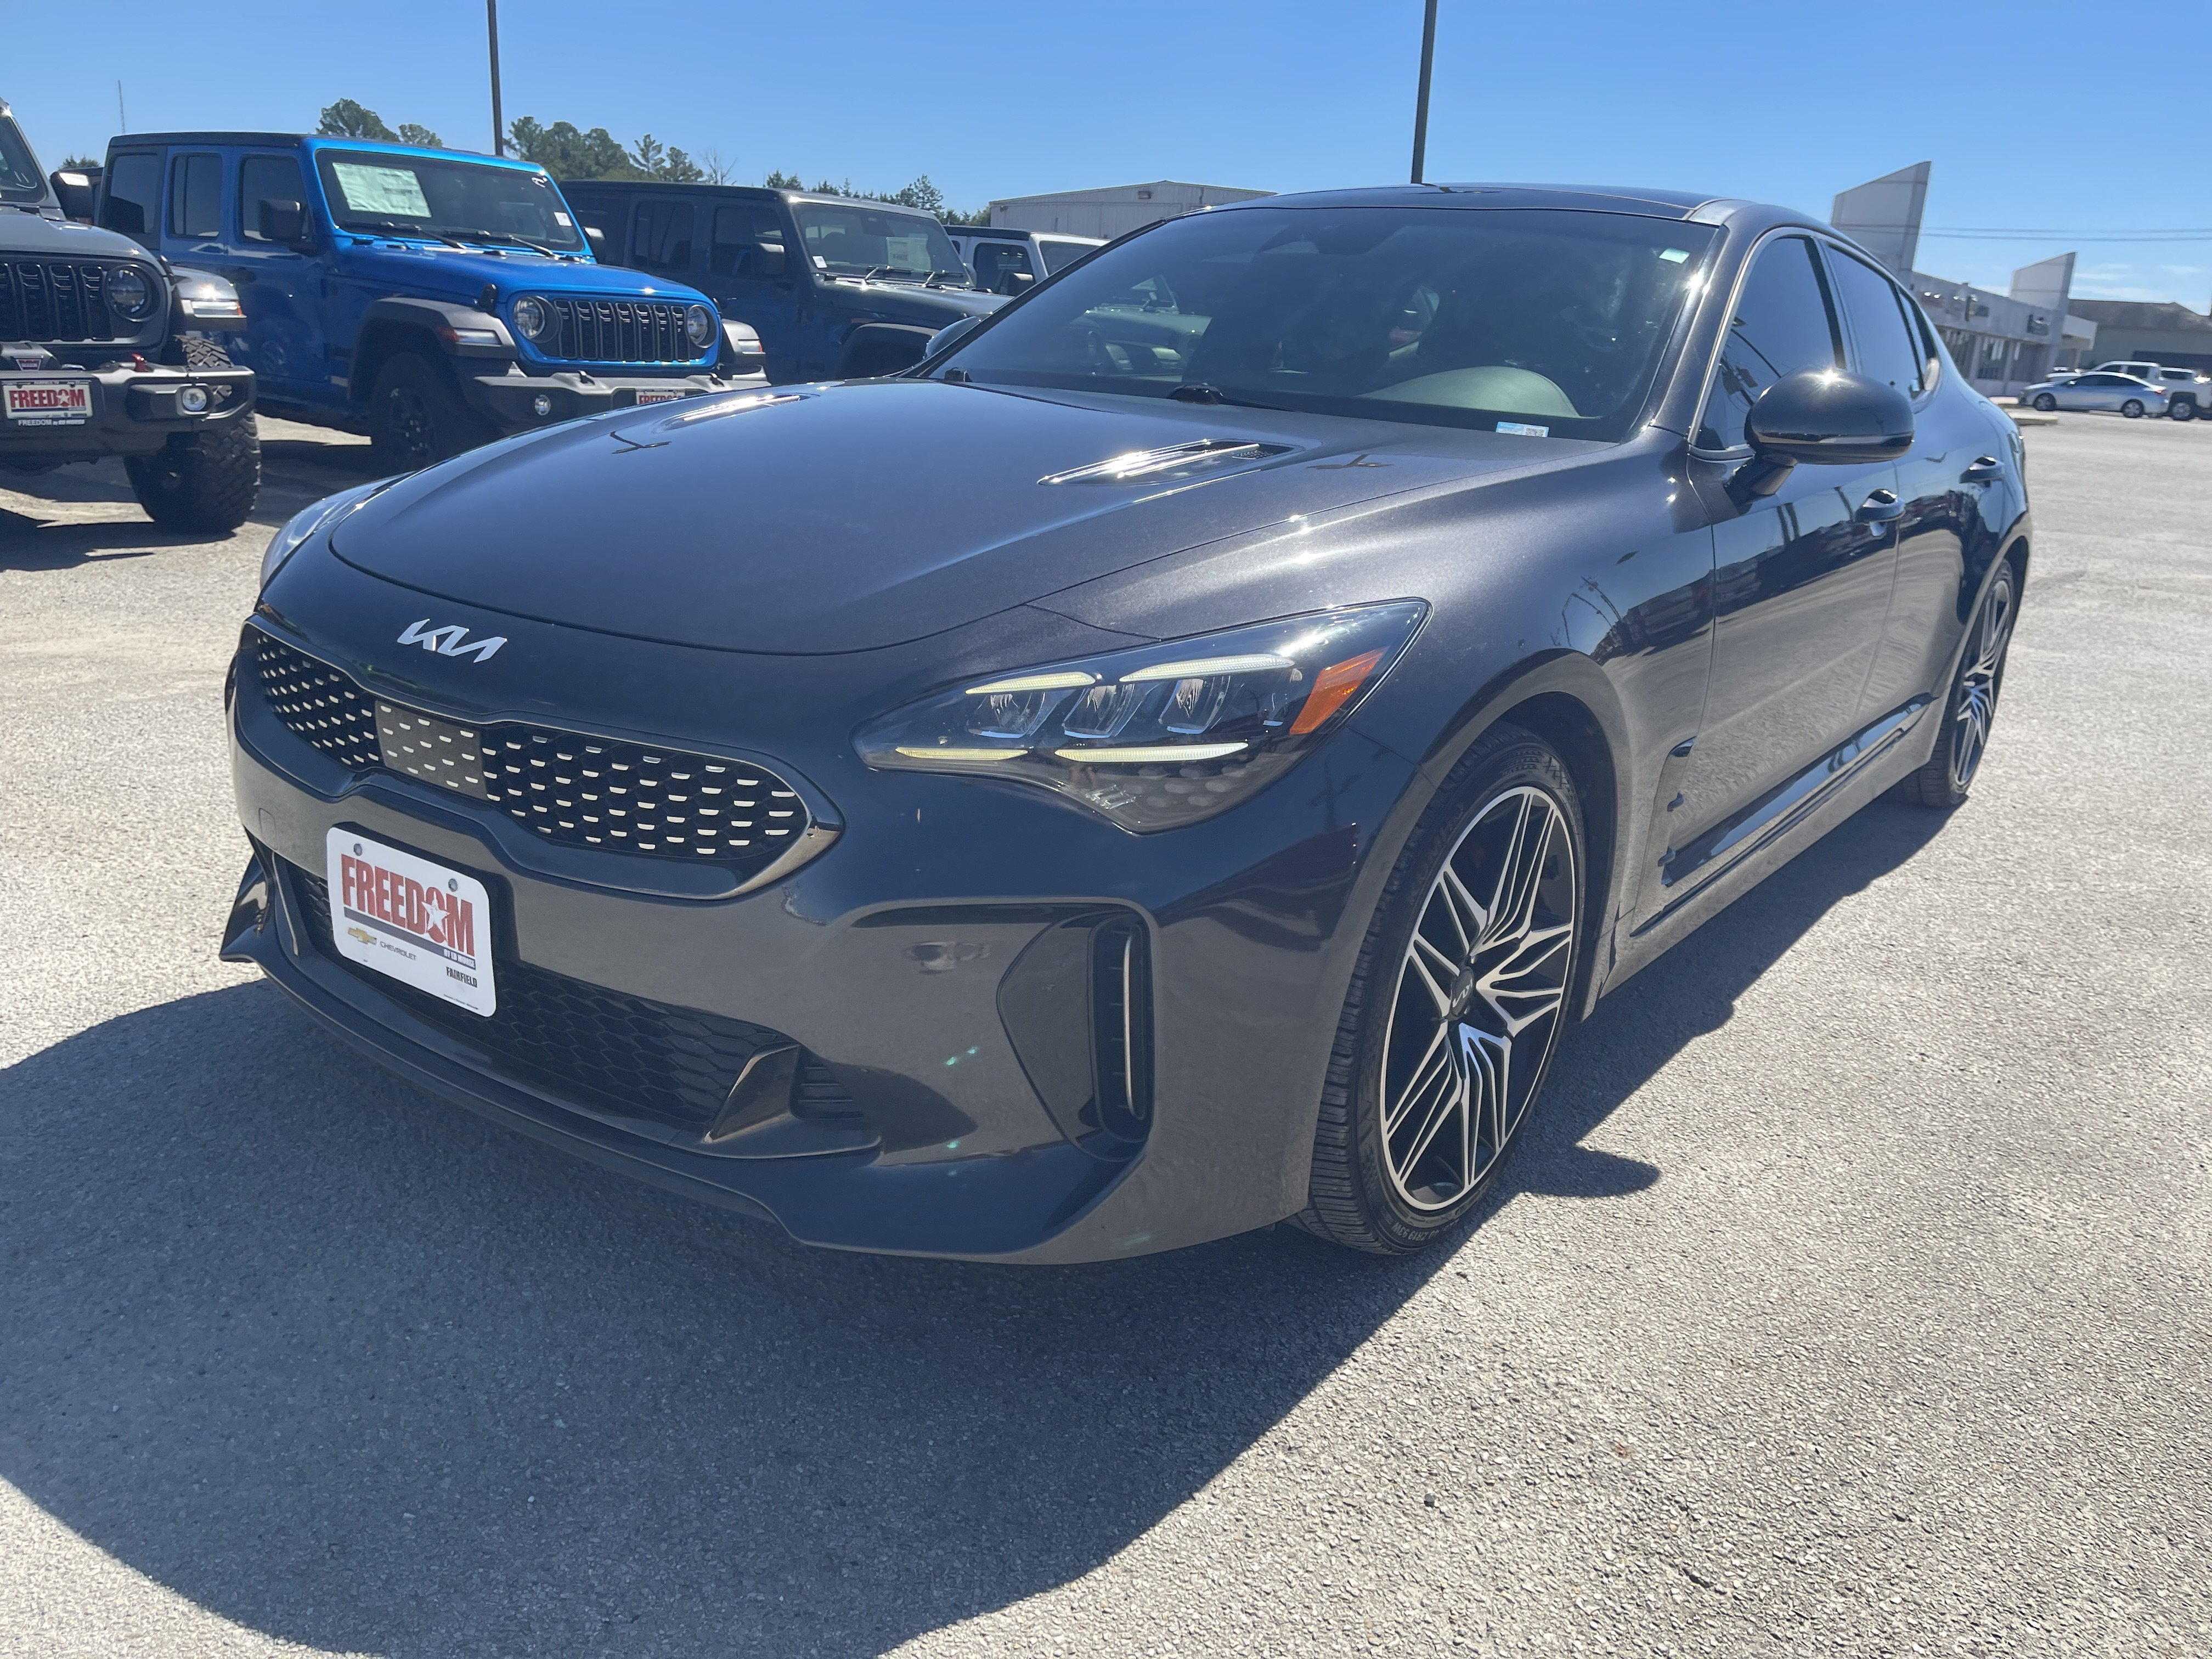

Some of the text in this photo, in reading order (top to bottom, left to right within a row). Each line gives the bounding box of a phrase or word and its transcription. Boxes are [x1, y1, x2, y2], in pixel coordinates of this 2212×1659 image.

[9, 389, 86, 408] FREEDOM
[397, 618, 507, 663] KIA
[341, 854, 475, 957] FREEDOM
[380, 941, 416, 961] CHEVROLET
[445, 966, 478, 988] FAIRFIELD
